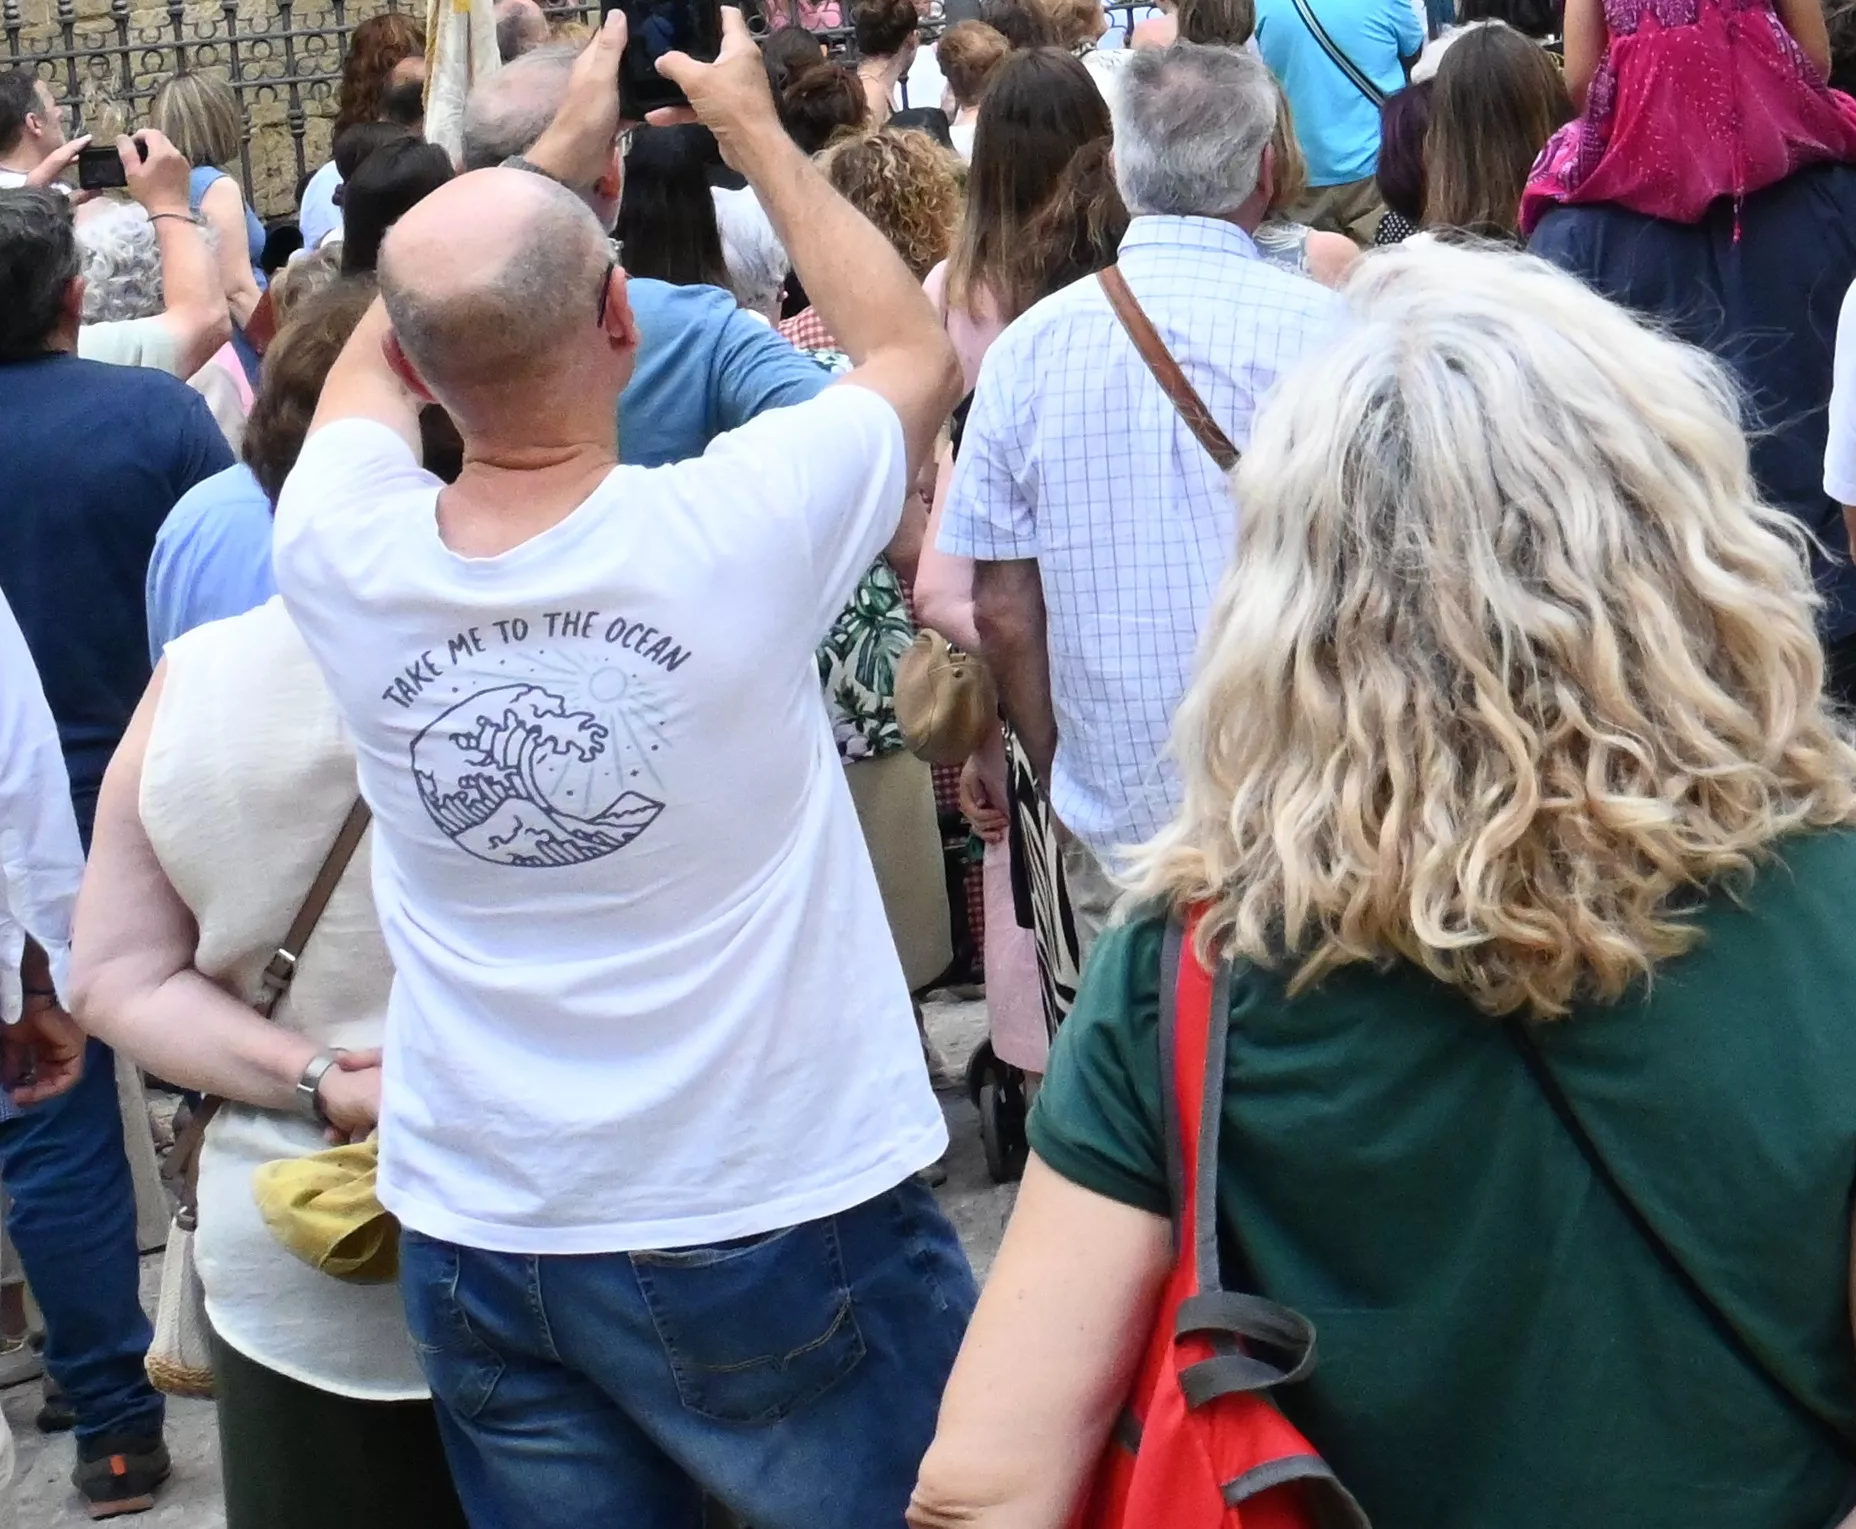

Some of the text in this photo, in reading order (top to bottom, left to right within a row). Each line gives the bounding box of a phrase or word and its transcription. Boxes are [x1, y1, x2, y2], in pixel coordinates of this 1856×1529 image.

[381, 610, 693, 708] TAKE ME TO THE OCEAN
